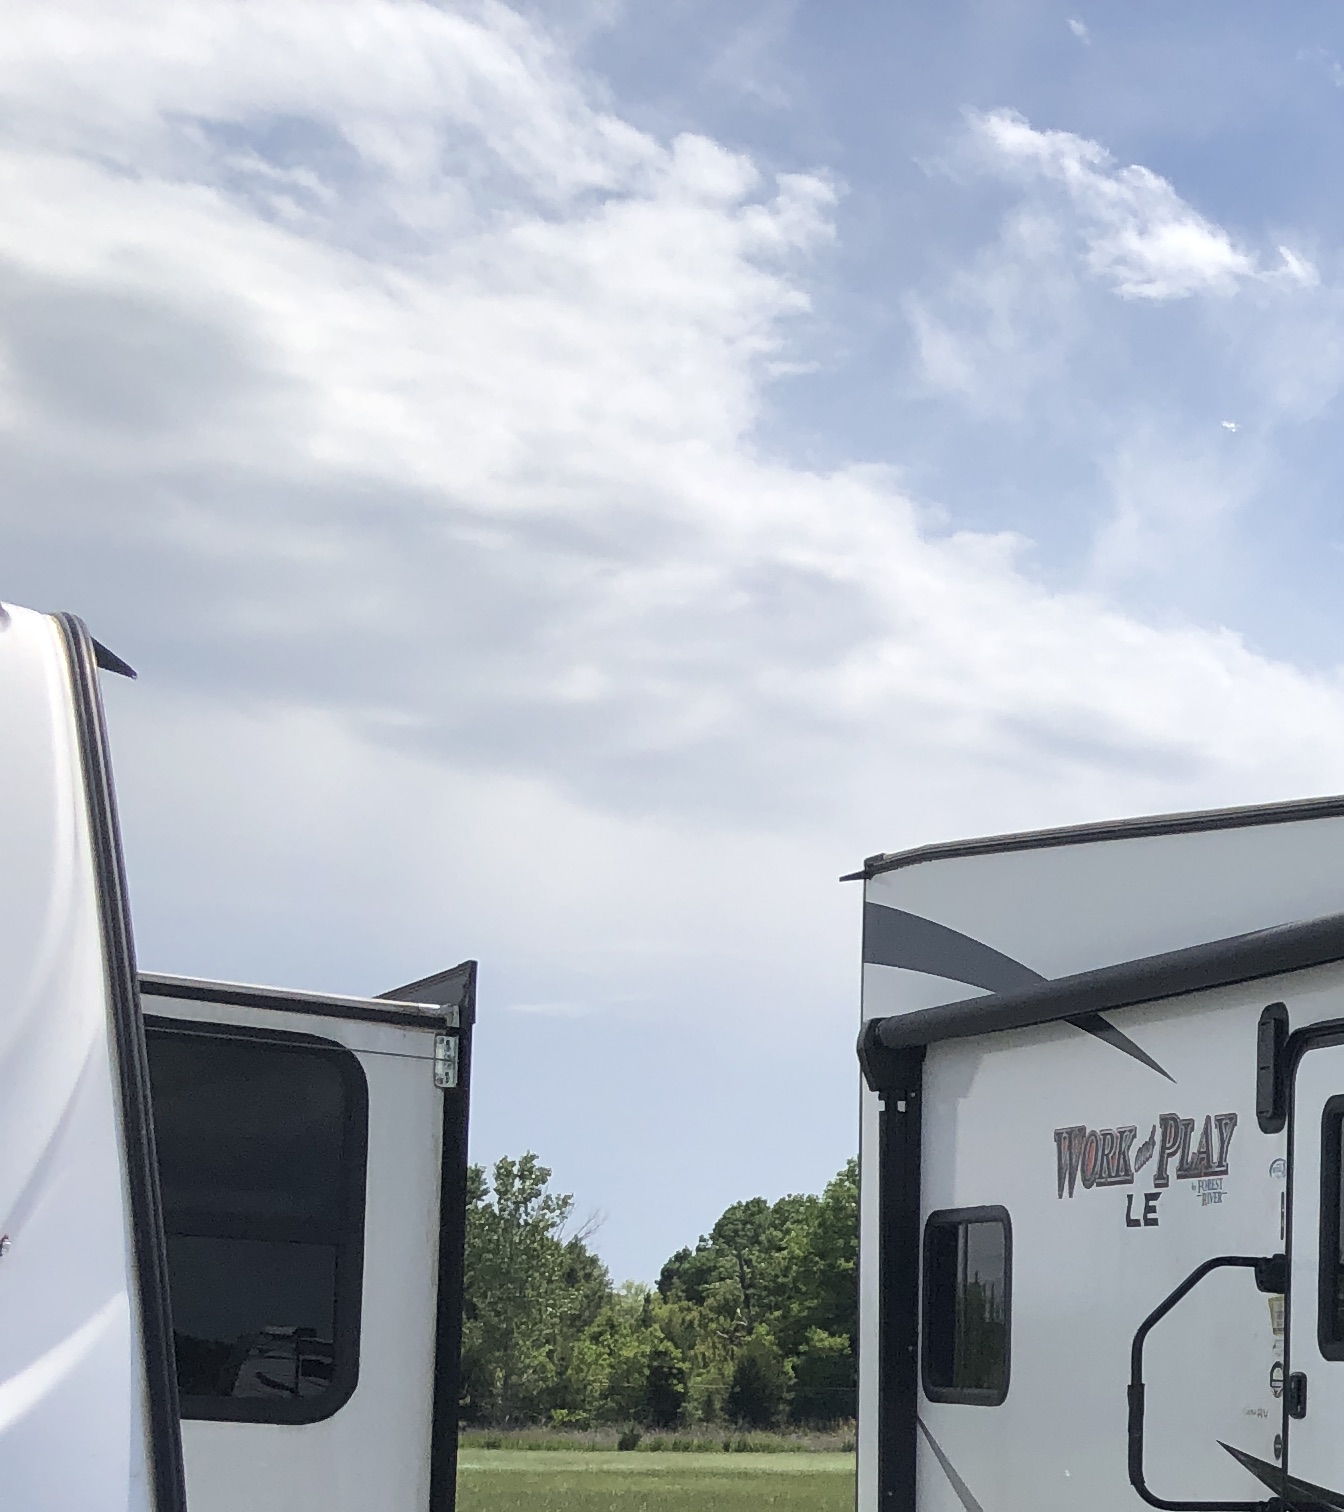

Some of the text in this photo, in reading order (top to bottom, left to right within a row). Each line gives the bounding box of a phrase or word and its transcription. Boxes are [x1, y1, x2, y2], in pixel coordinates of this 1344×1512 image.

[1054, 1125, 1137, 1199] WORK
[1153, 1112, 1238, 1188] PLAY
[1125, 1192, 1162, 1227] LE
[1202, 1192, 1222, 1206] RIVER
